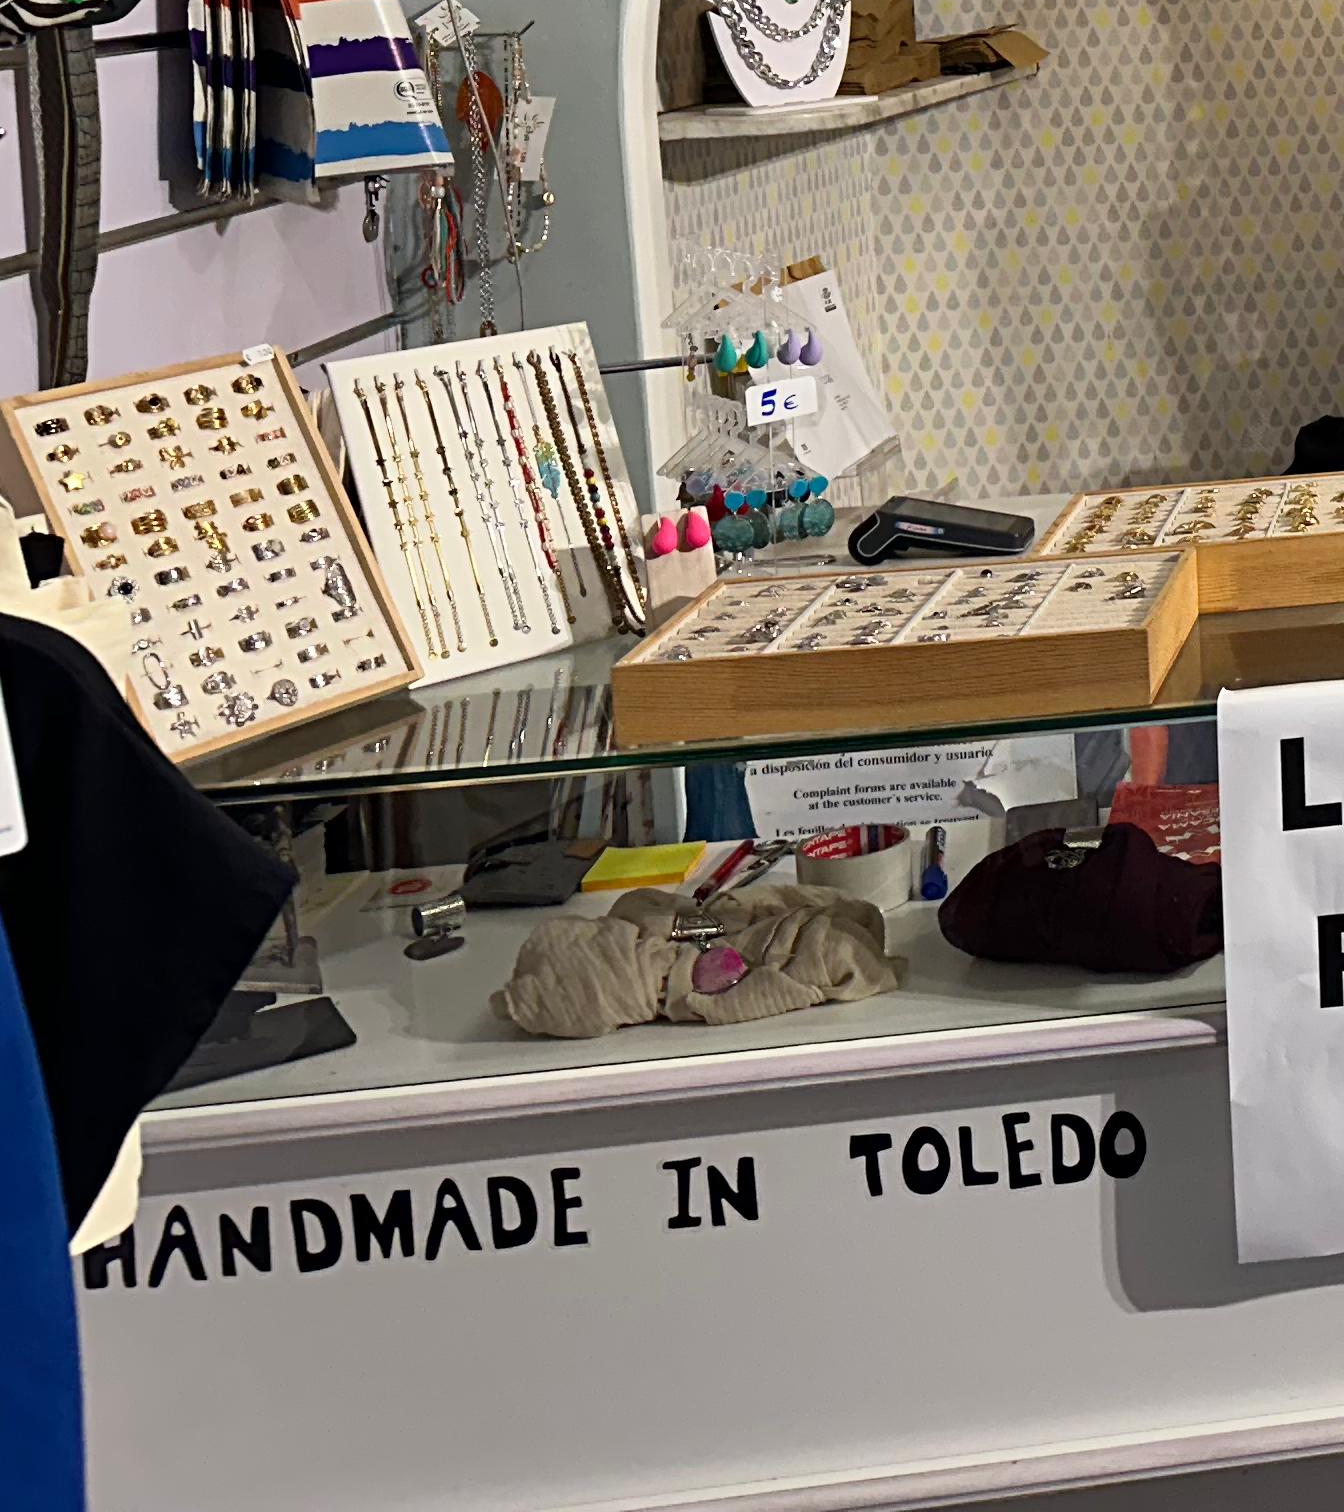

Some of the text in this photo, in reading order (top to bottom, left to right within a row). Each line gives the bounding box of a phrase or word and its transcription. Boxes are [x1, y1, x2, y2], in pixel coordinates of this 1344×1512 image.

[761, 759, 831, 776] disposición
[834, 756, 853, 769] del
[857, 751, 931, 767] consumidor
[934, 753, 942, 764] y
[946, 746, 993, 761] usuario
[793, 778, 957, 800] Complaint forms are available
[808, 800, 819, 811] at
[822, 798, 840, 809] the
[82, 1109, 1147, 1290] HANDMADE IN TOLEDO
